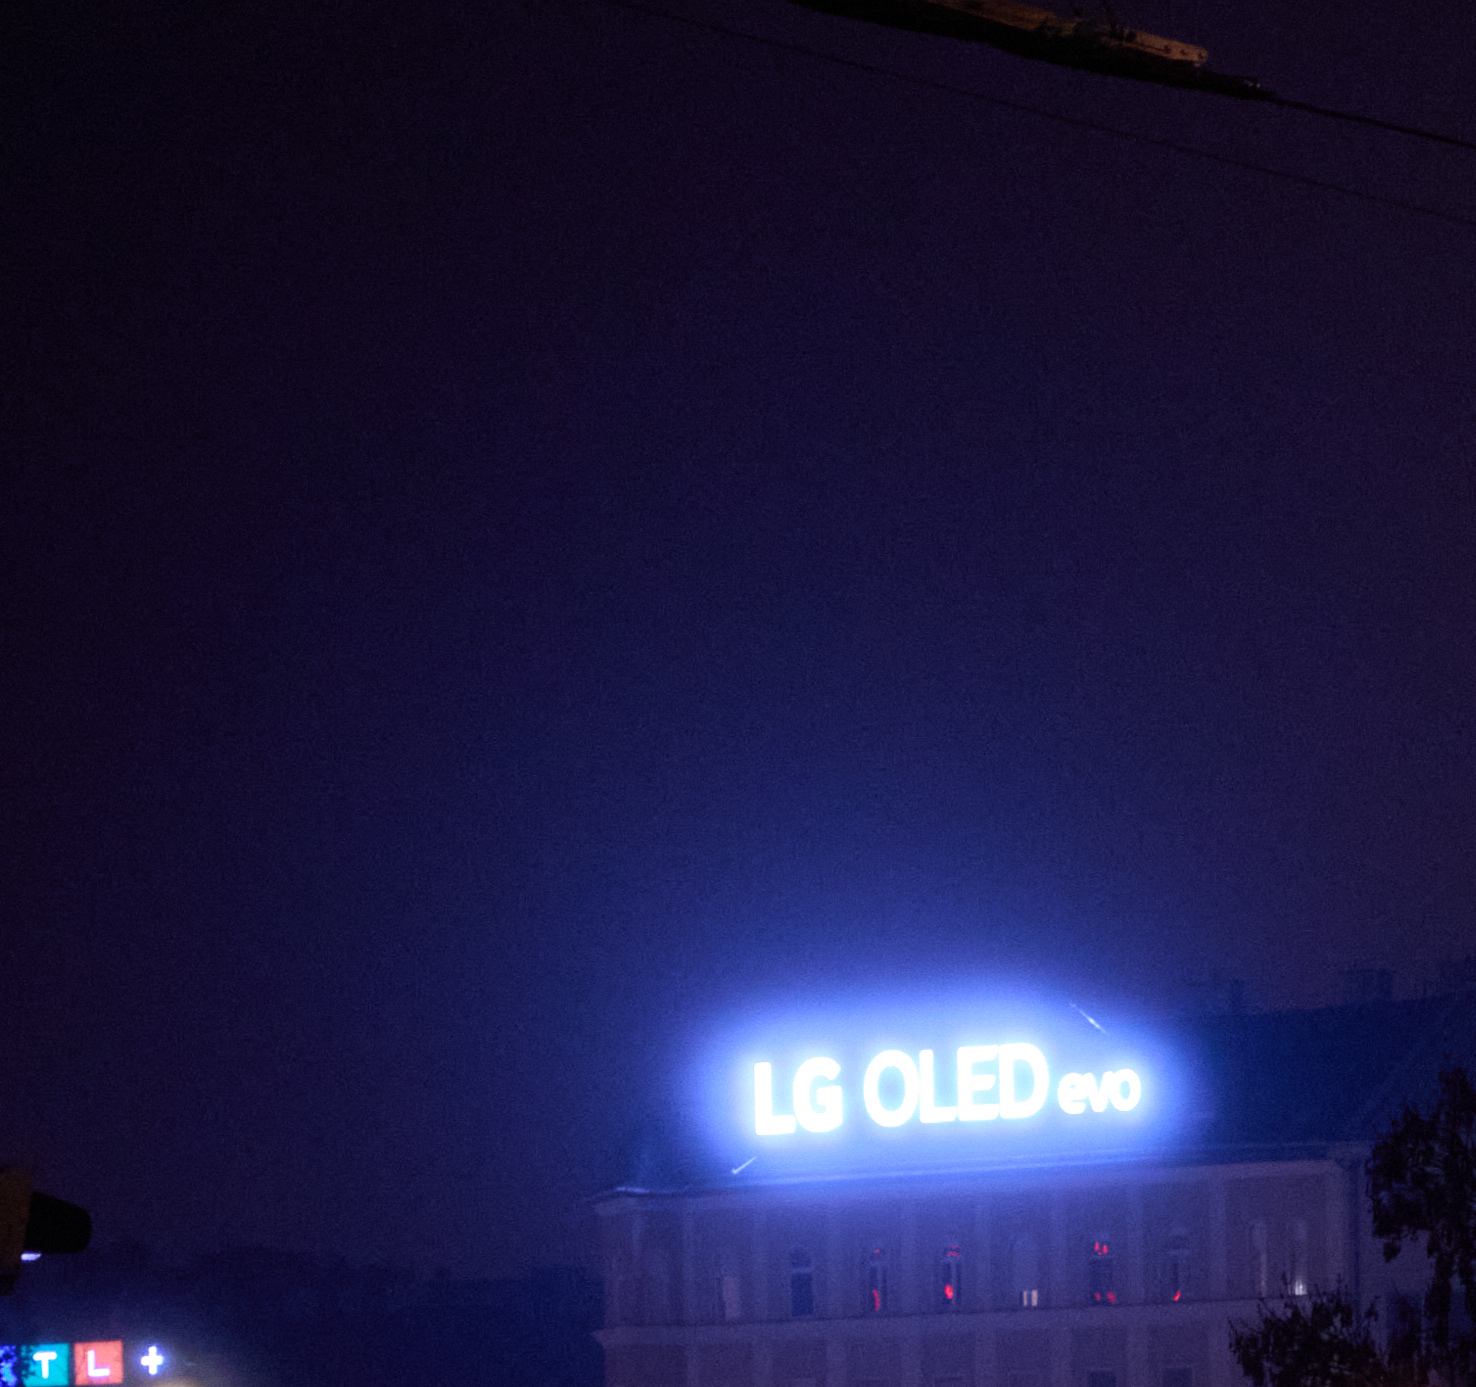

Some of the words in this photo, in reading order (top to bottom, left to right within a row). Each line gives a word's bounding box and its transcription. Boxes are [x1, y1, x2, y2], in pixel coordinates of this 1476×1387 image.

[753, 1056, 843, 1136] LG
[863, 1042, 1050, 1128] OLED
[1057, 1068, 1142, 1115] evo
